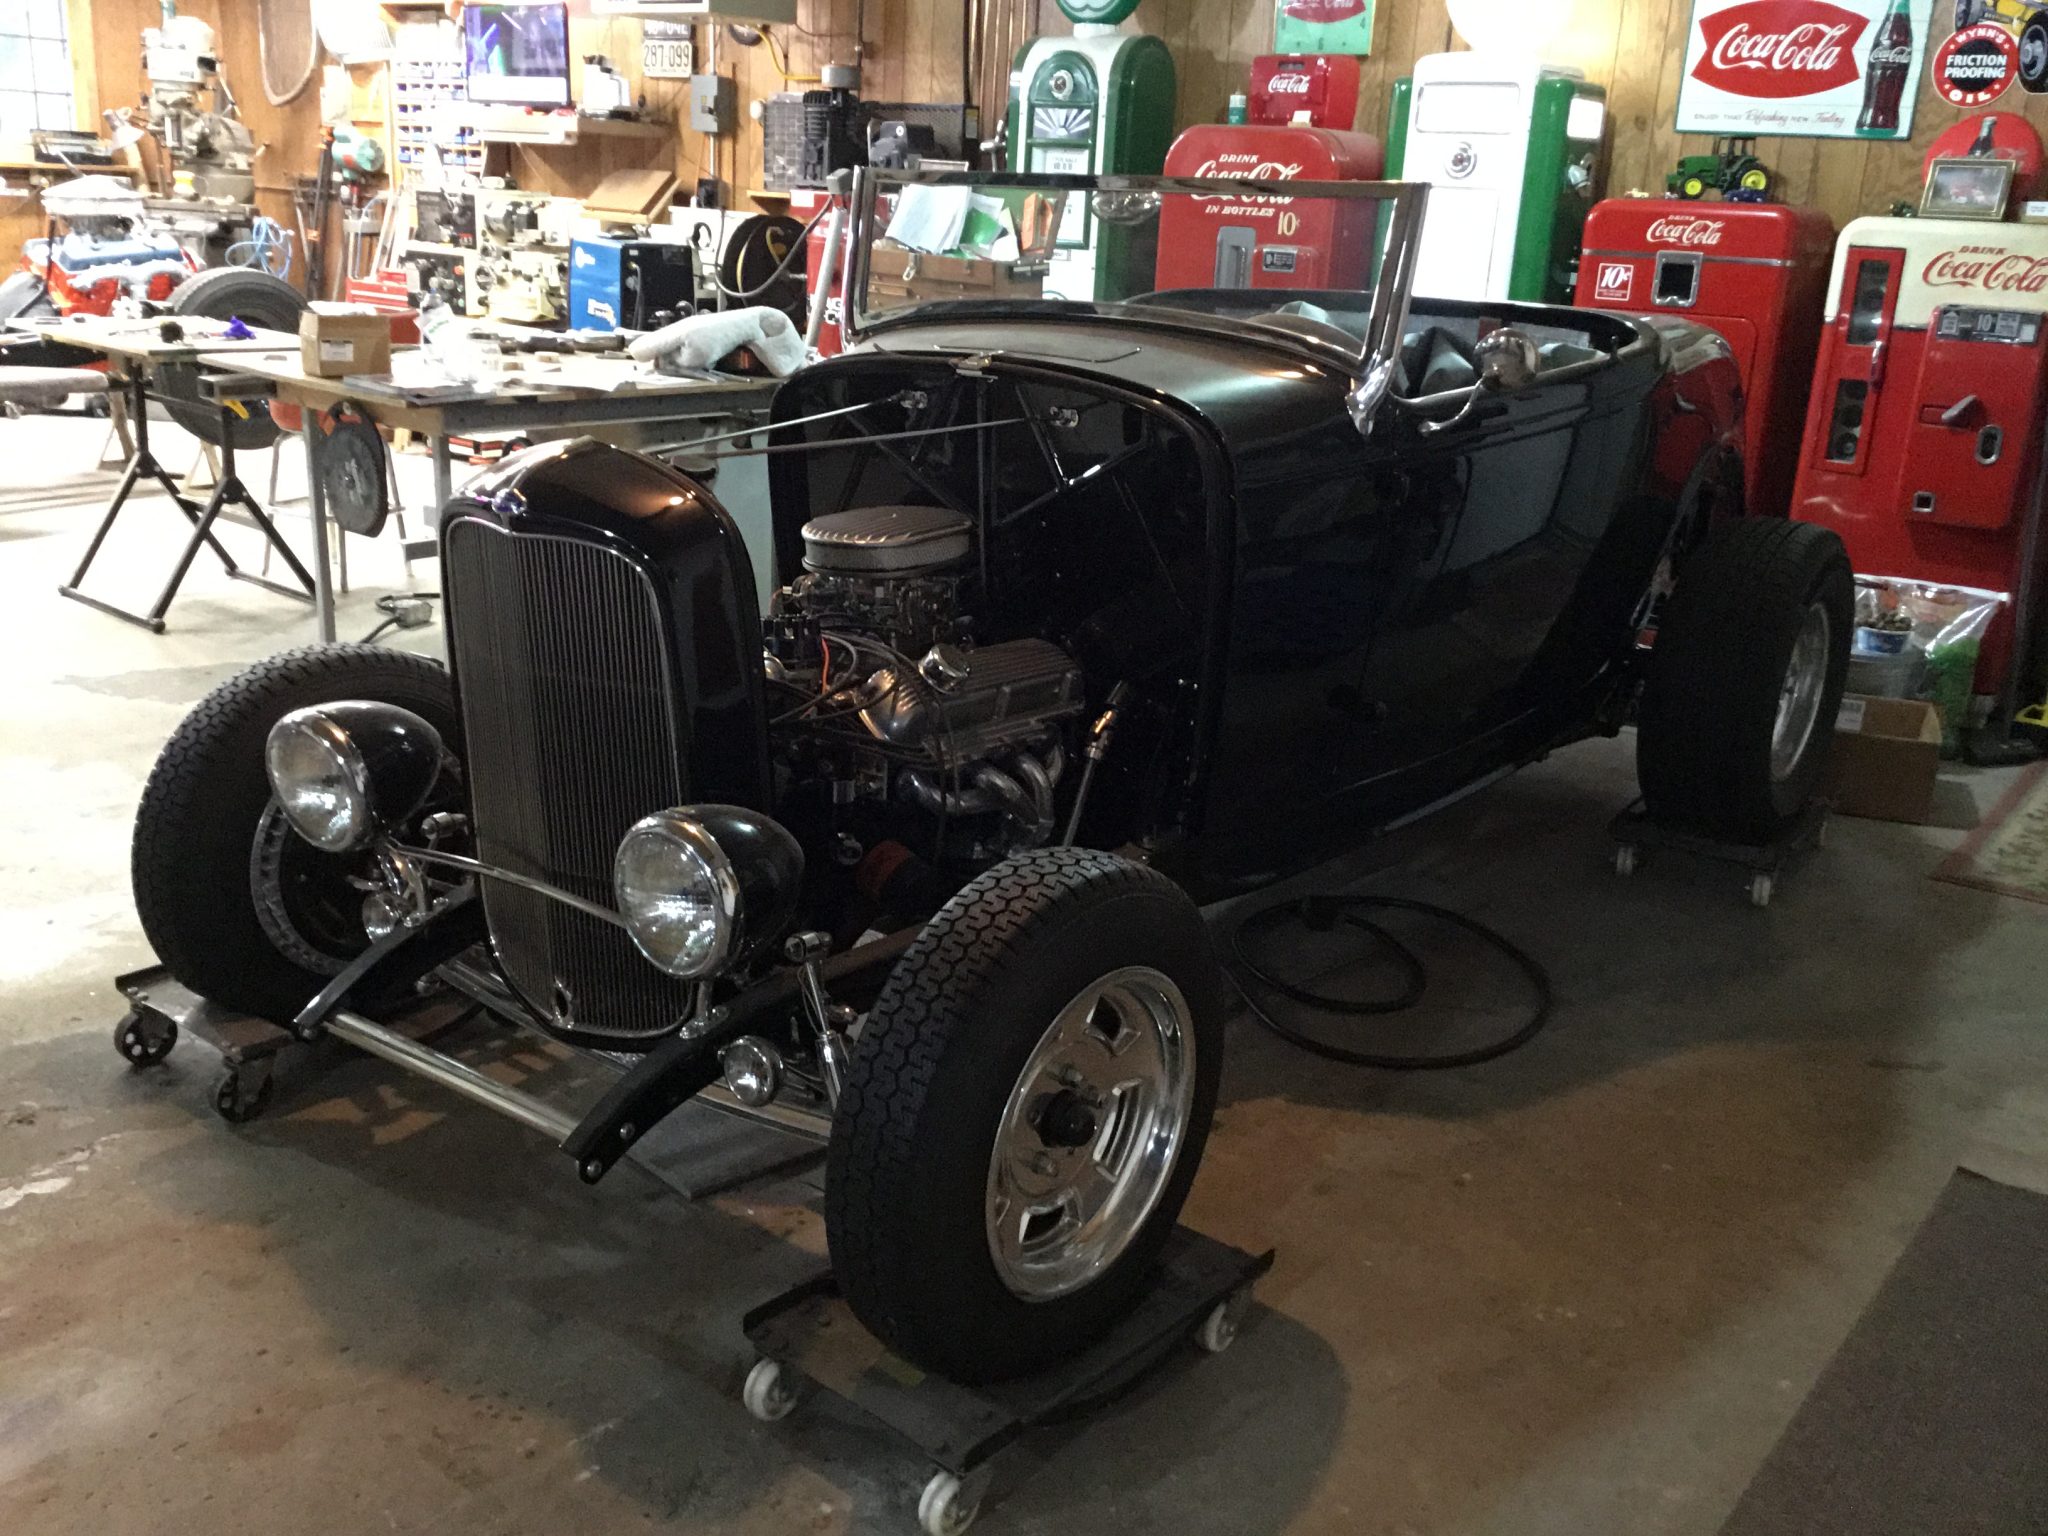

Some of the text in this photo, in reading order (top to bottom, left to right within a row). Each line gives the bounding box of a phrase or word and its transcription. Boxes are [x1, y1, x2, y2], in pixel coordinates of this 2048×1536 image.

[1711, 23, 1851, 70] Coca-Cola
[1946, 54, 2008, 66] FRICTION
[1944, 67, 2007, 78] PROOFING
[1268, 74, 1311, 93] Coca-Cola
[1949, 89, 1991, 103] OIL
[1219, 153, 1259, 163] DRINK
[1205, 204, 1275, 217] IN BOTTLES
[1646, 218, 1726, 245] Coca-Cola
[1958, 245, 2007, 255] DRINK
[1922, 251, 2048, 293] Coca-Cola
